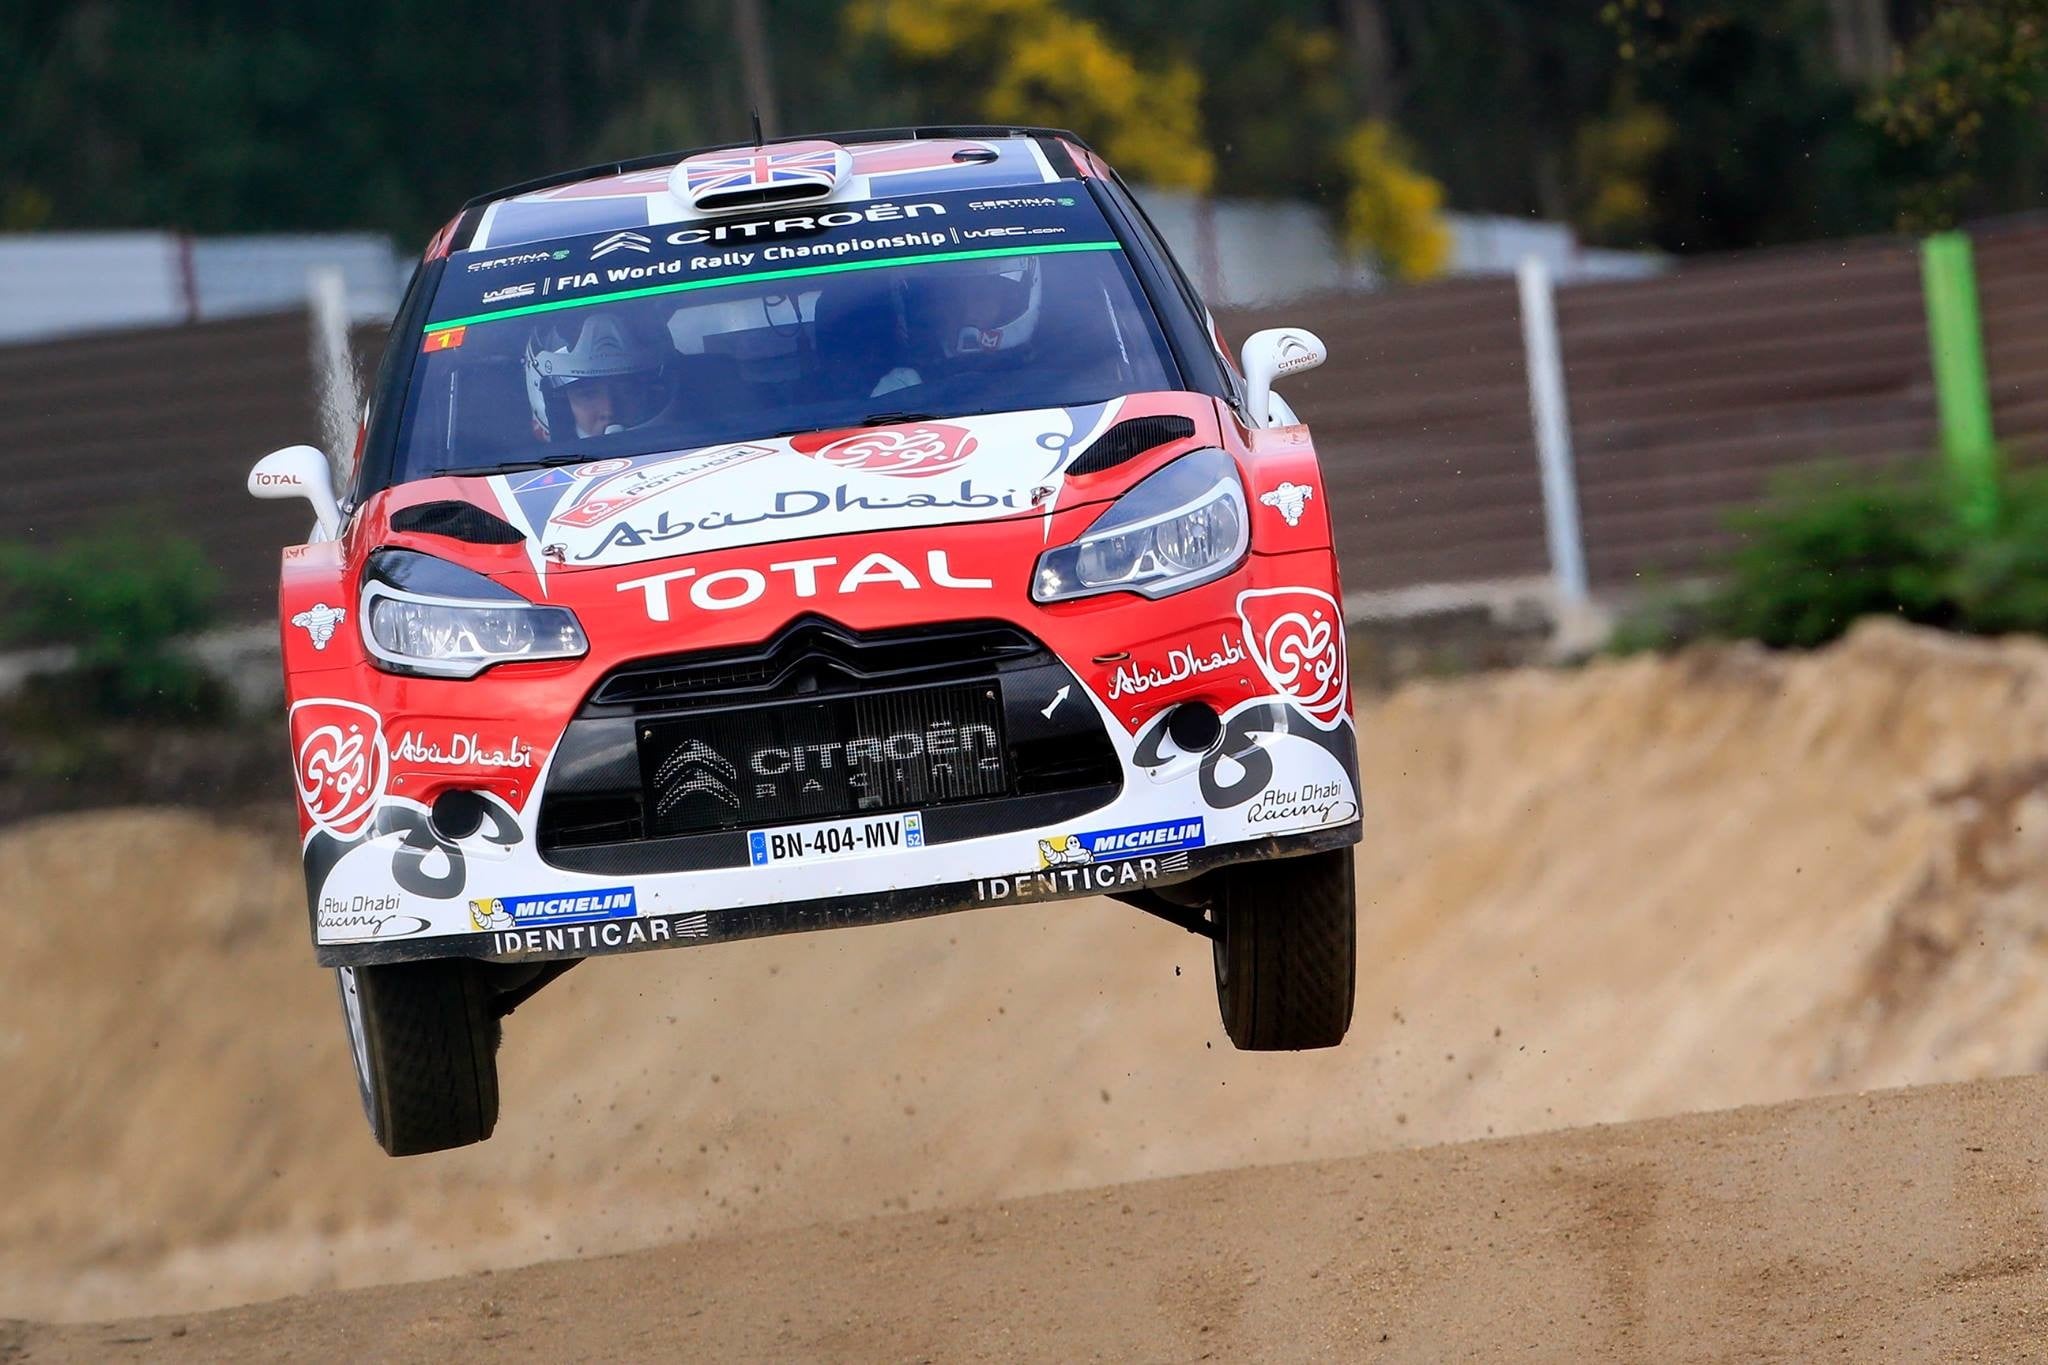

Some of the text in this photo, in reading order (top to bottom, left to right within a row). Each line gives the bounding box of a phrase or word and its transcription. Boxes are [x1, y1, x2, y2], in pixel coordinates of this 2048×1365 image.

[969, 197, 1056, 209] CERTINA
[666, 202, 947, 246] CITROËN
[467, 251, 550, 271] CERTINA
[483, 282, 536, 300] WRC
[557, 272, 600, 291] FIA
[607, 258, 682, 283] World
[690, 250, 755, 272] Rally
[763, 225, 946, 262] Championship
[437, 333, 449, 348] 1
[255, 472, 302, 486] TOTAL
[615, 549, 993, 623] TOTAL
[1262, 779, 1342, 808] Abu Dhabi
[1246, 800, 1342, 825] Racing
[771, 820, 901, 861] BN-404-MV
[906, 833, 921, 847] 52
[1093, 821, 1202, 854] MICHELIN
[756, 851, 764, 863] F
[976, 856, 1159, 902] IDENTICAR
[324, 893, 400, 914] Abu Dhabi
[514, 892, 633, 918] MICHELIN
[318, 908, 397, 935] Racing
[494, 917, 671, 956] IDENTICAR
